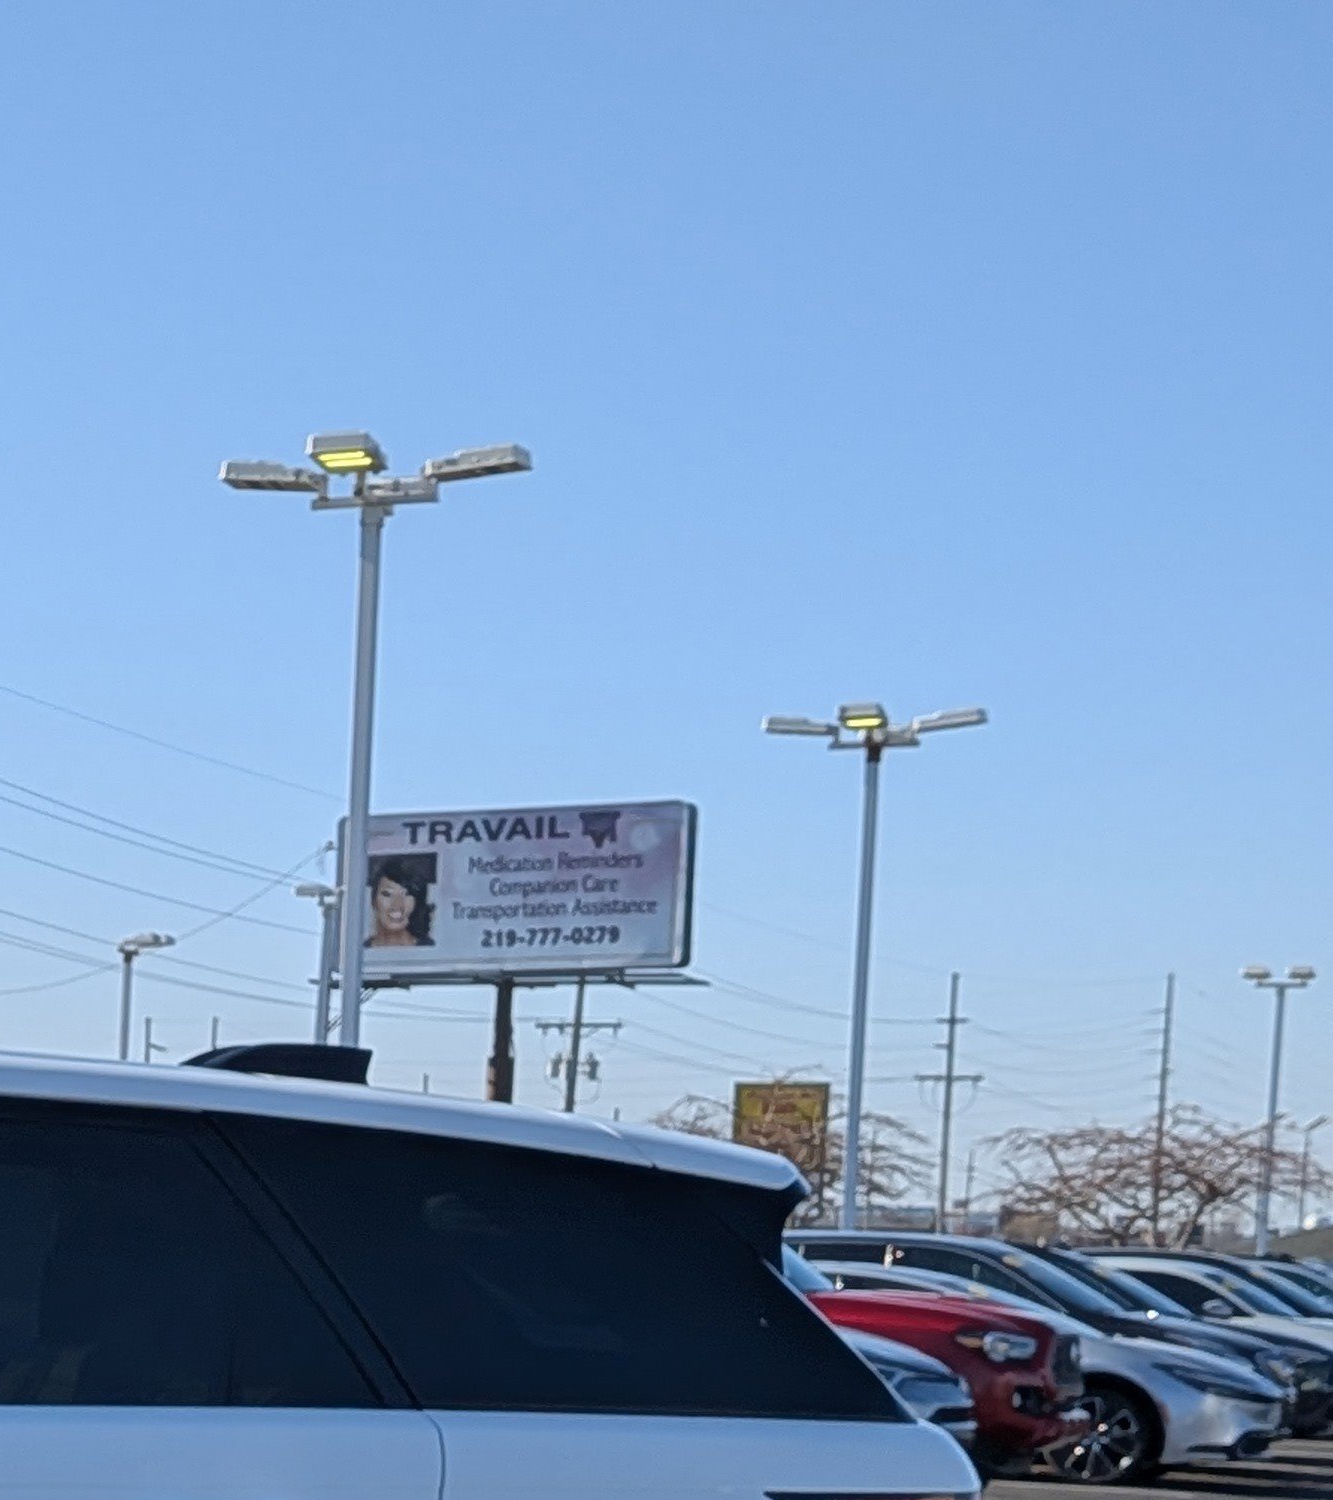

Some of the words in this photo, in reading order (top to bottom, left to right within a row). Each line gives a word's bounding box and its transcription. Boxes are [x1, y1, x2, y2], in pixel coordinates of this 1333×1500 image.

[402, 815, 570, 845] TRAVAIL
[468, 855, 554, 874] Medication
[557, 851, 644, 869] Reminders
[489, 877, 578, 898] Companion
[582, 874, 619, 892] Care
[452, 901, 568, 924] Transportation
[571, 899, 658, 915] Assistance
